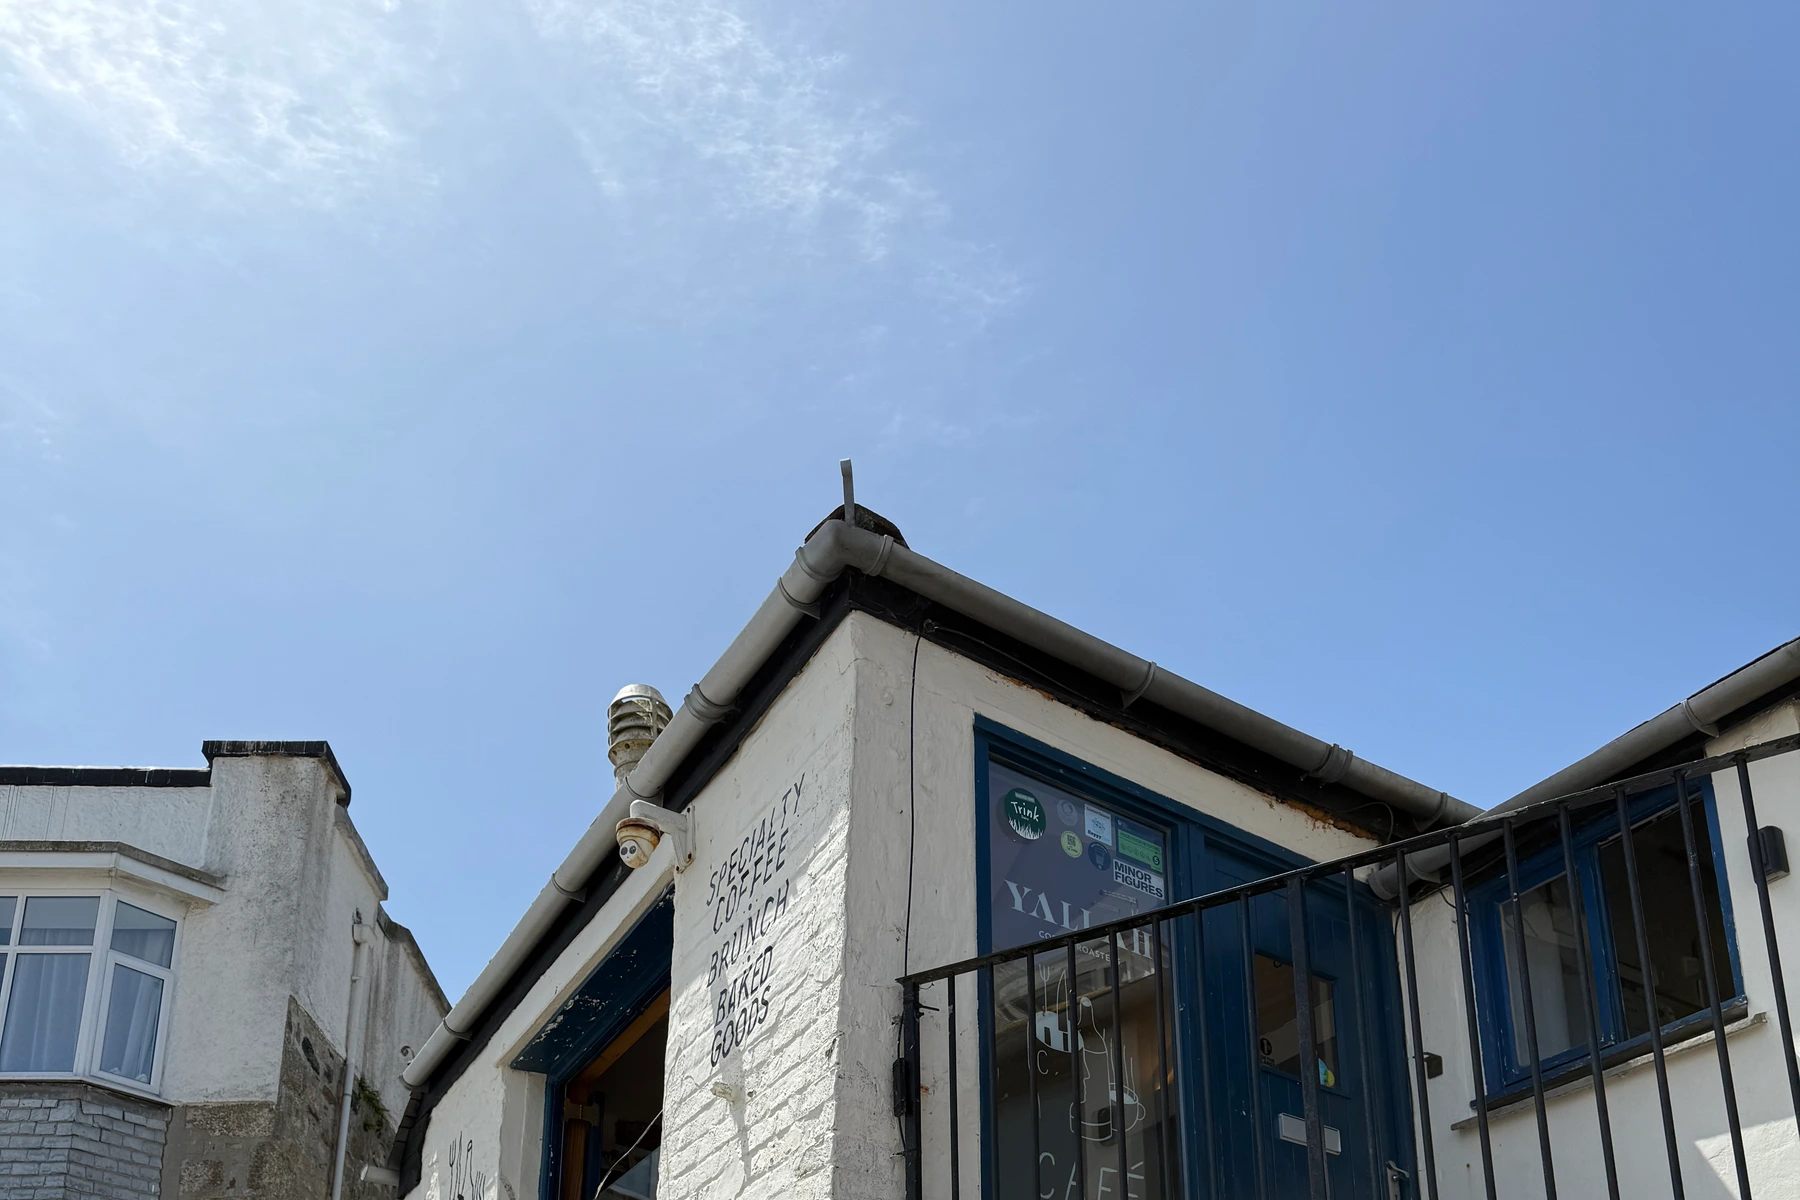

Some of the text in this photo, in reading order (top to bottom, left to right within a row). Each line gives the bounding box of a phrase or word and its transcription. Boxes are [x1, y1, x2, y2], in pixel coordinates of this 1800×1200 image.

[706, 773, 806, 906] SPECIALTY
[1010, 801, 1040, 822] Trink
[711, 828, 790, 935] COFFEE
[1114, 861, 1152, 883] MINOR
[1114, 873, 1163, 898] FIGURES
[707, 879, 790, 988] BRUNCH
[710, 986, 770, 1068] GOODS
[713, 946, 773, 1027] BAKED
